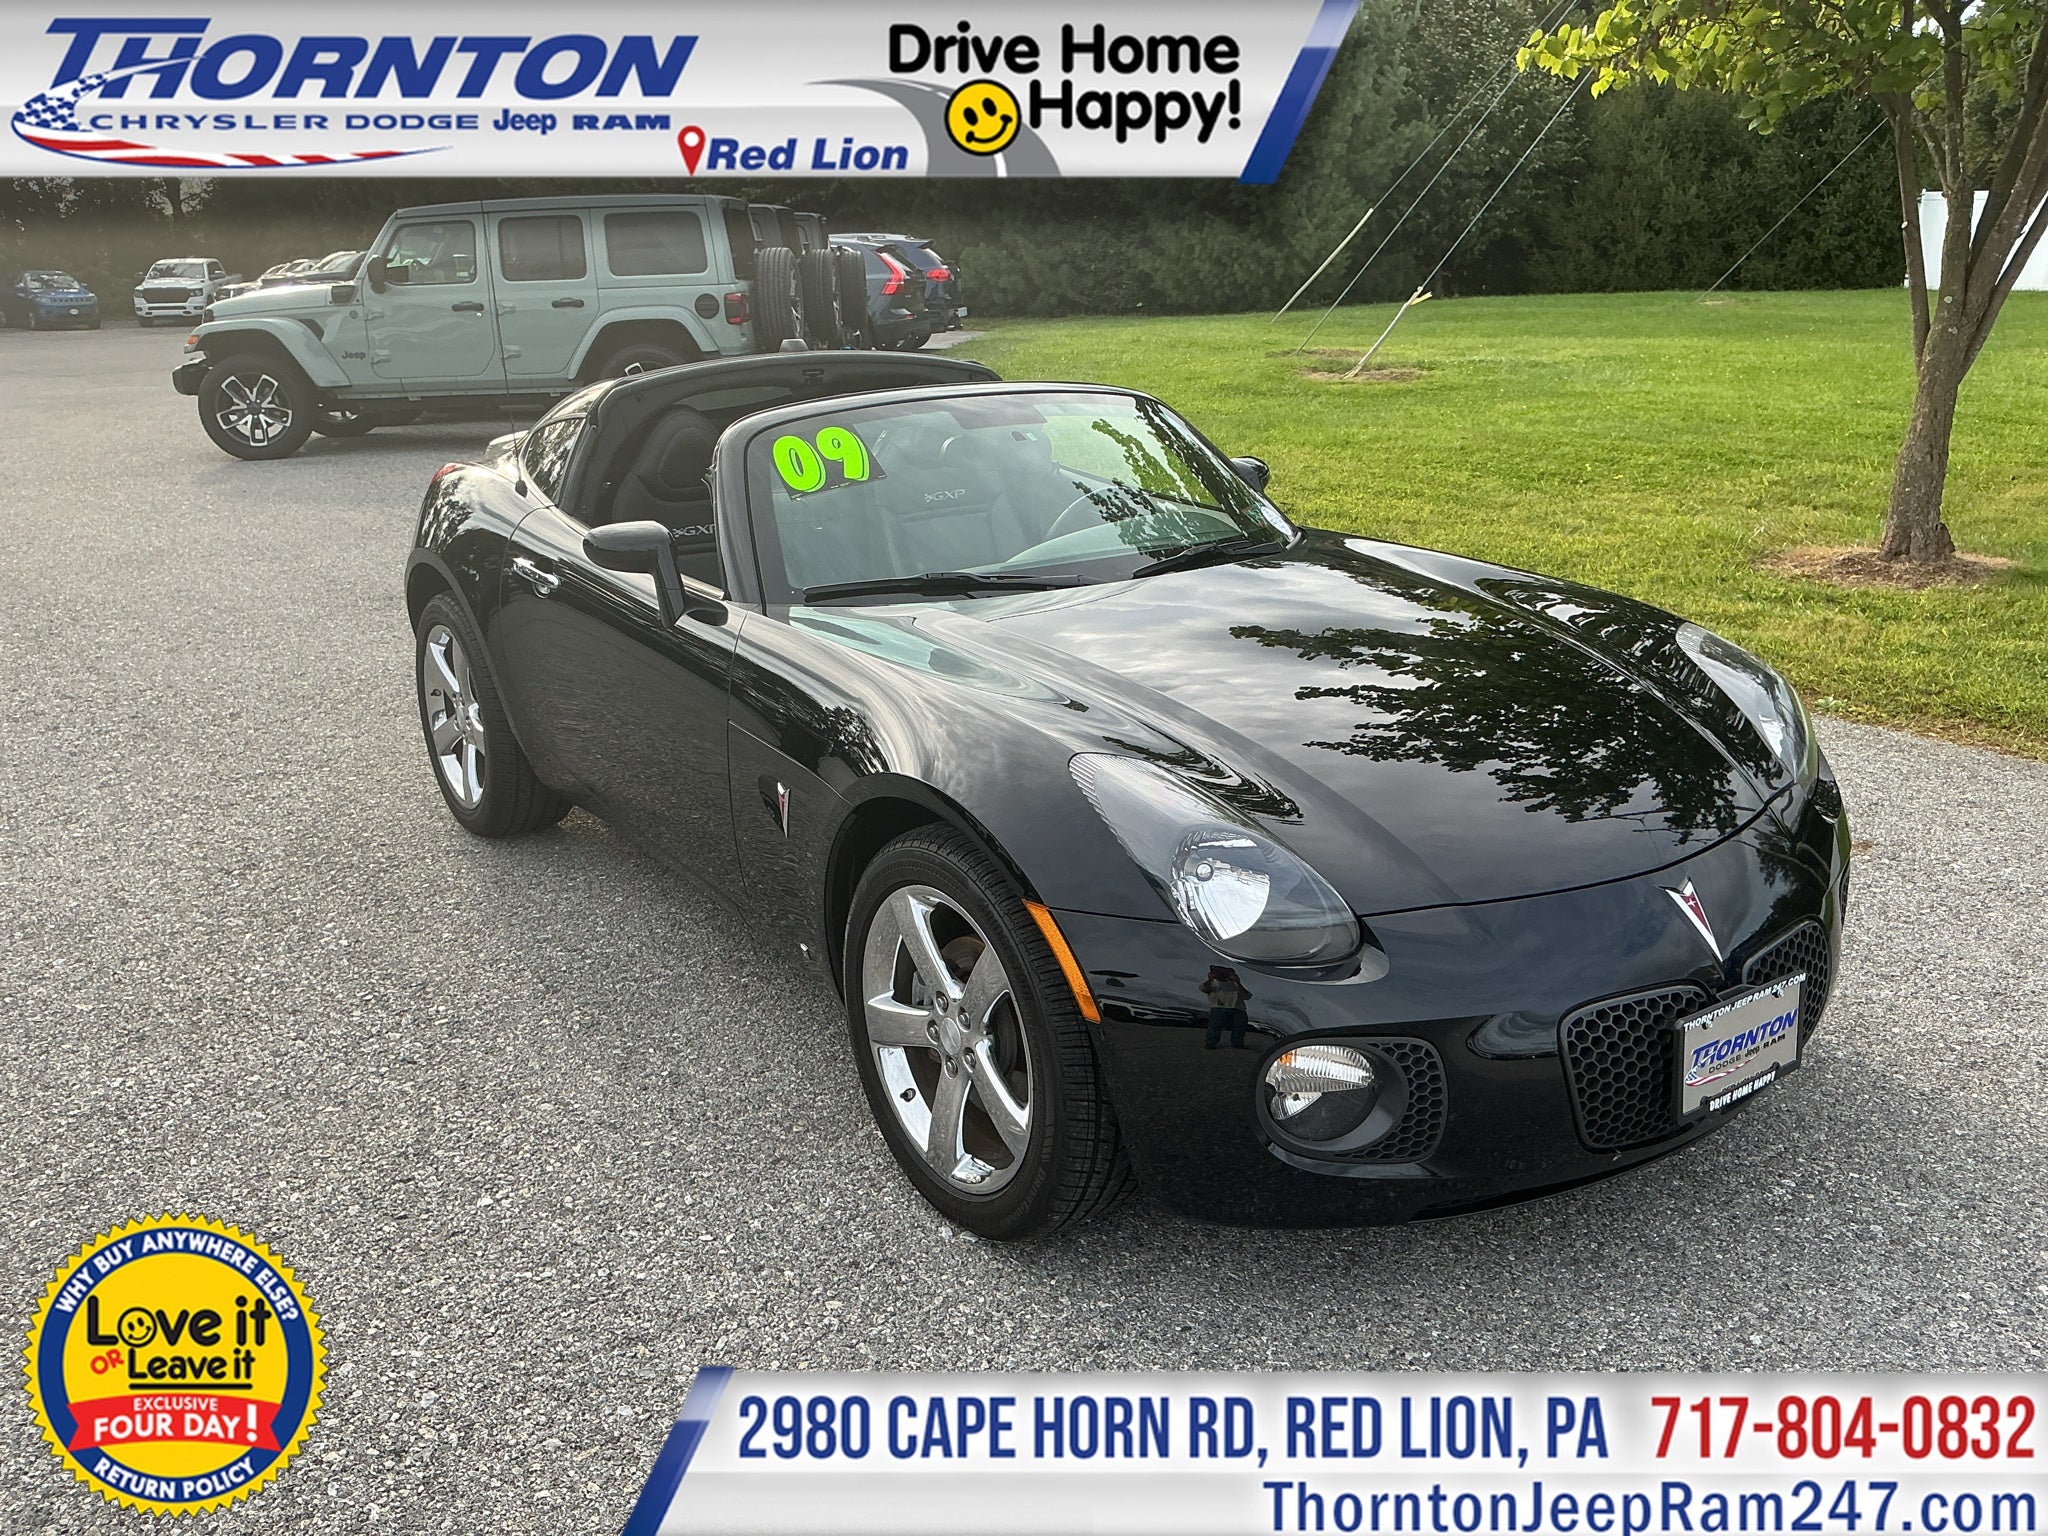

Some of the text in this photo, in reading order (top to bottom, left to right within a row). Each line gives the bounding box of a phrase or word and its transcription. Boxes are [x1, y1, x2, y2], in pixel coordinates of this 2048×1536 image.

[341, 350, 367, 360] Jeep
[773, 426, 870, 492] 09
[934, 488, 966, 500] GXP
[1690, 1008, 1799, 1069] THORNTON
[1708, 1053, 1742, 1074] DODGE
[1763, 1033, 1786, 1049] RAM
[1709, 1091, 1732, 1112] DRIVE
[1732, 1081, 1753, 1101] HOME
[1753, 1070, 1776, 1093] HAPPY
